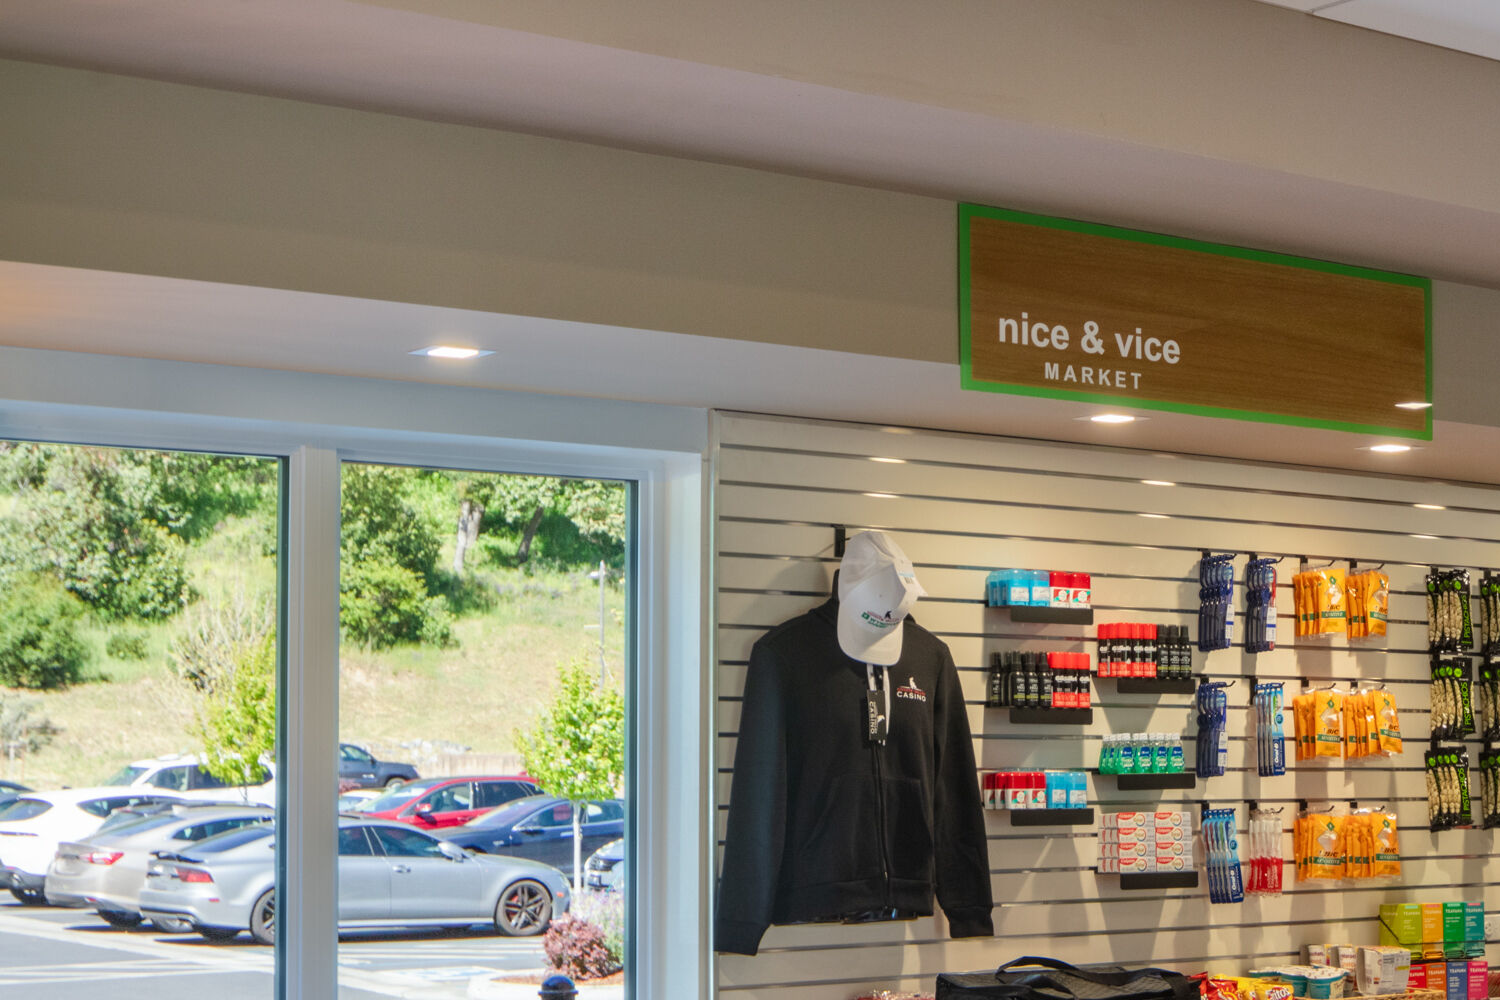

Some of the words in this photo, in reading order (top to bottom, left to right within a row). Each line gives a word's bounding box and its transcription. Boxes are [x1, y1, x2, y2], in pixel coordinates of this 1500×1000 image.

[999, 312, 1069, 350] nice
[1081, 320, 1104, 355] &
[1114, 327, 1180, 364] vice
[1045, 362, 1142, 389] MARKET
[896, 691, 927, 702] CASINO
